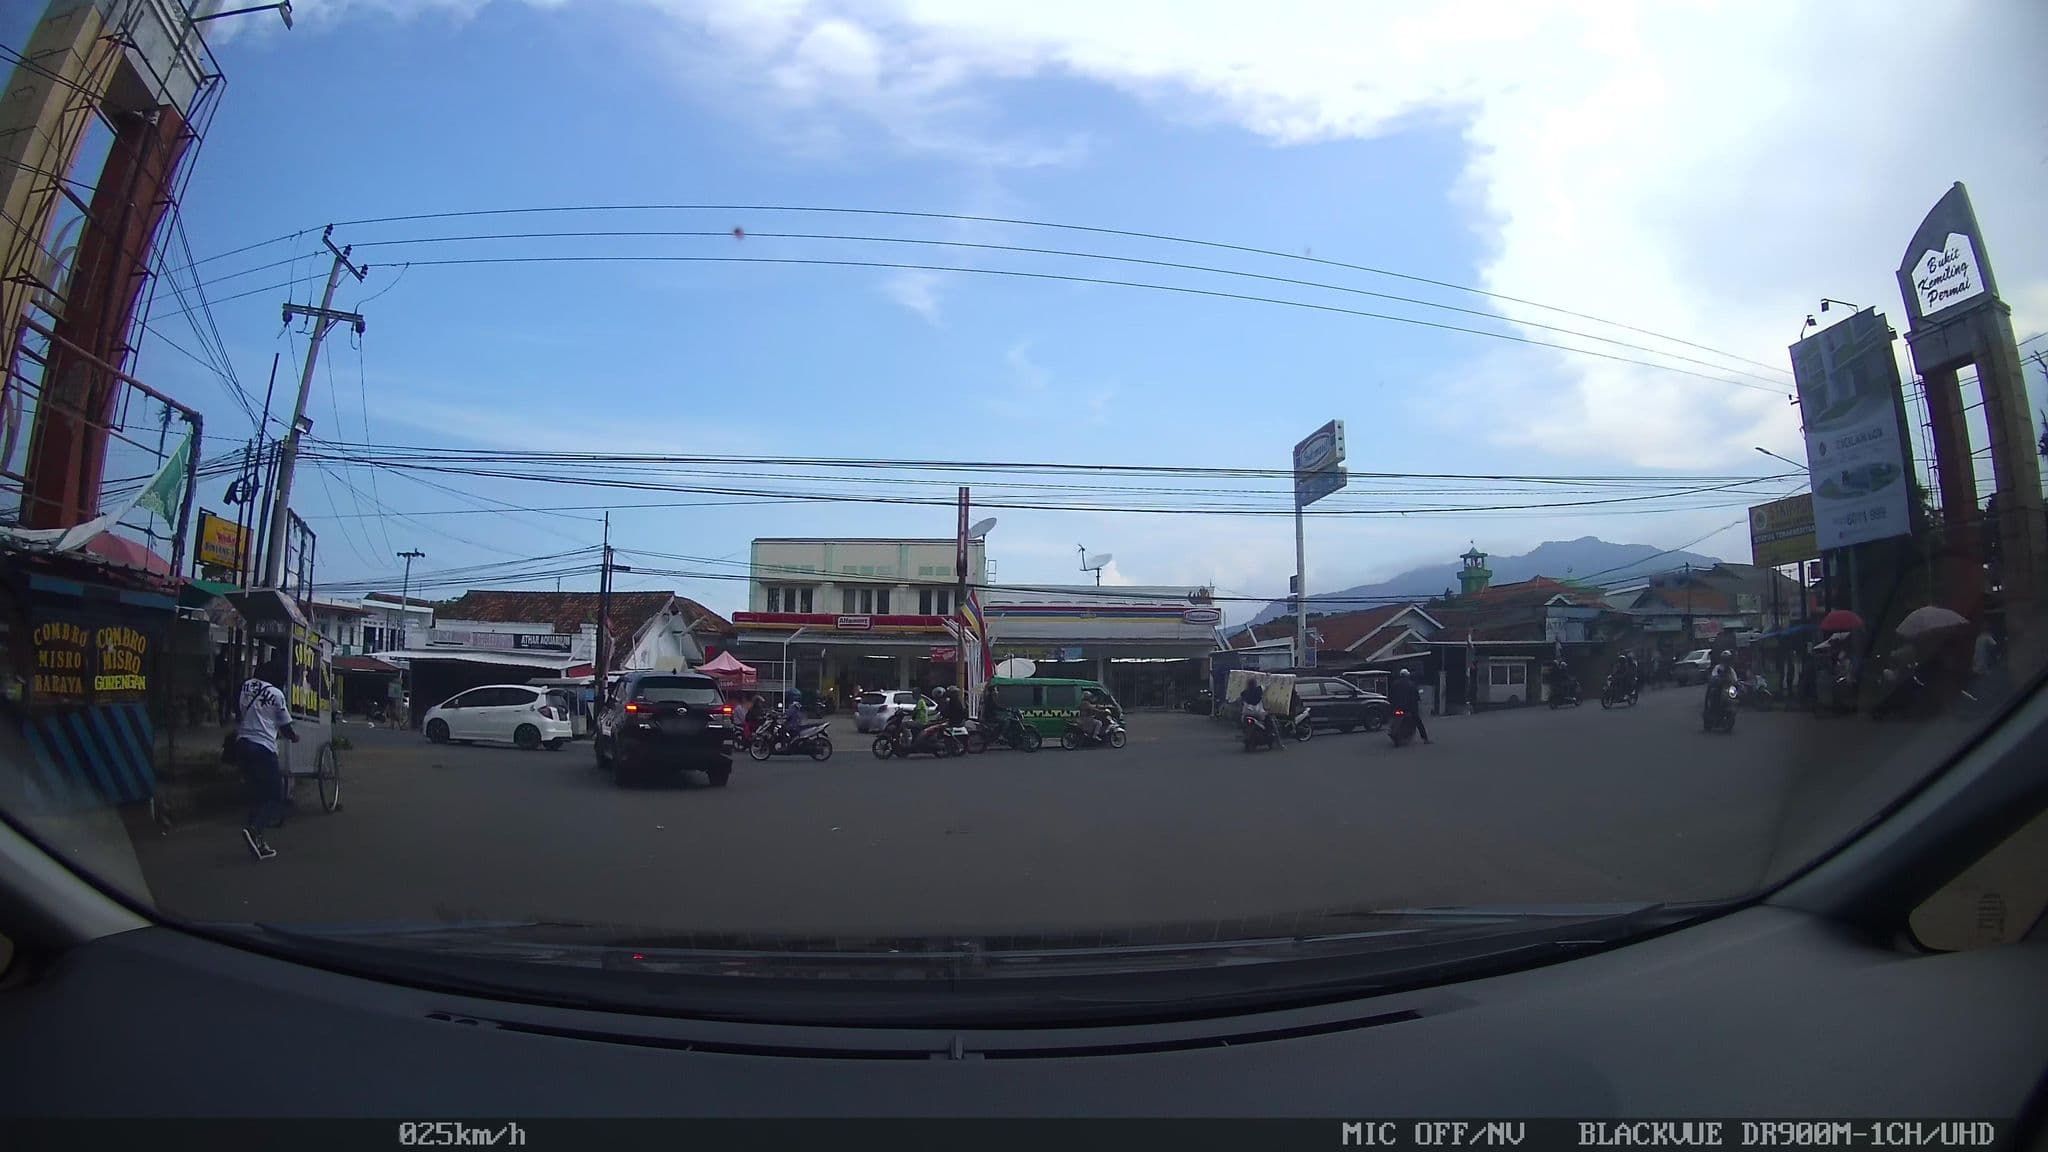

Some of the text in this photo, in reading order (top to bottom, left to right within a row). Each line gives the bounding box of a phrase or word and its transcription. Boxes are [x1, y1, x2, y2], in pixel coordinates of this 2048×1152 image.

[1927, 248, 1960, 273] Bukit
[1918, 262, 1969, 295] Kemiling
[1927, 277, 1971, 307] Permai
[34, 622, 87, 648] COMBRO
[97, 626, 147, 654] COMBRO
[39, 650, 81, 669] MISRO
[103, 649, 141, 674] MISRO
